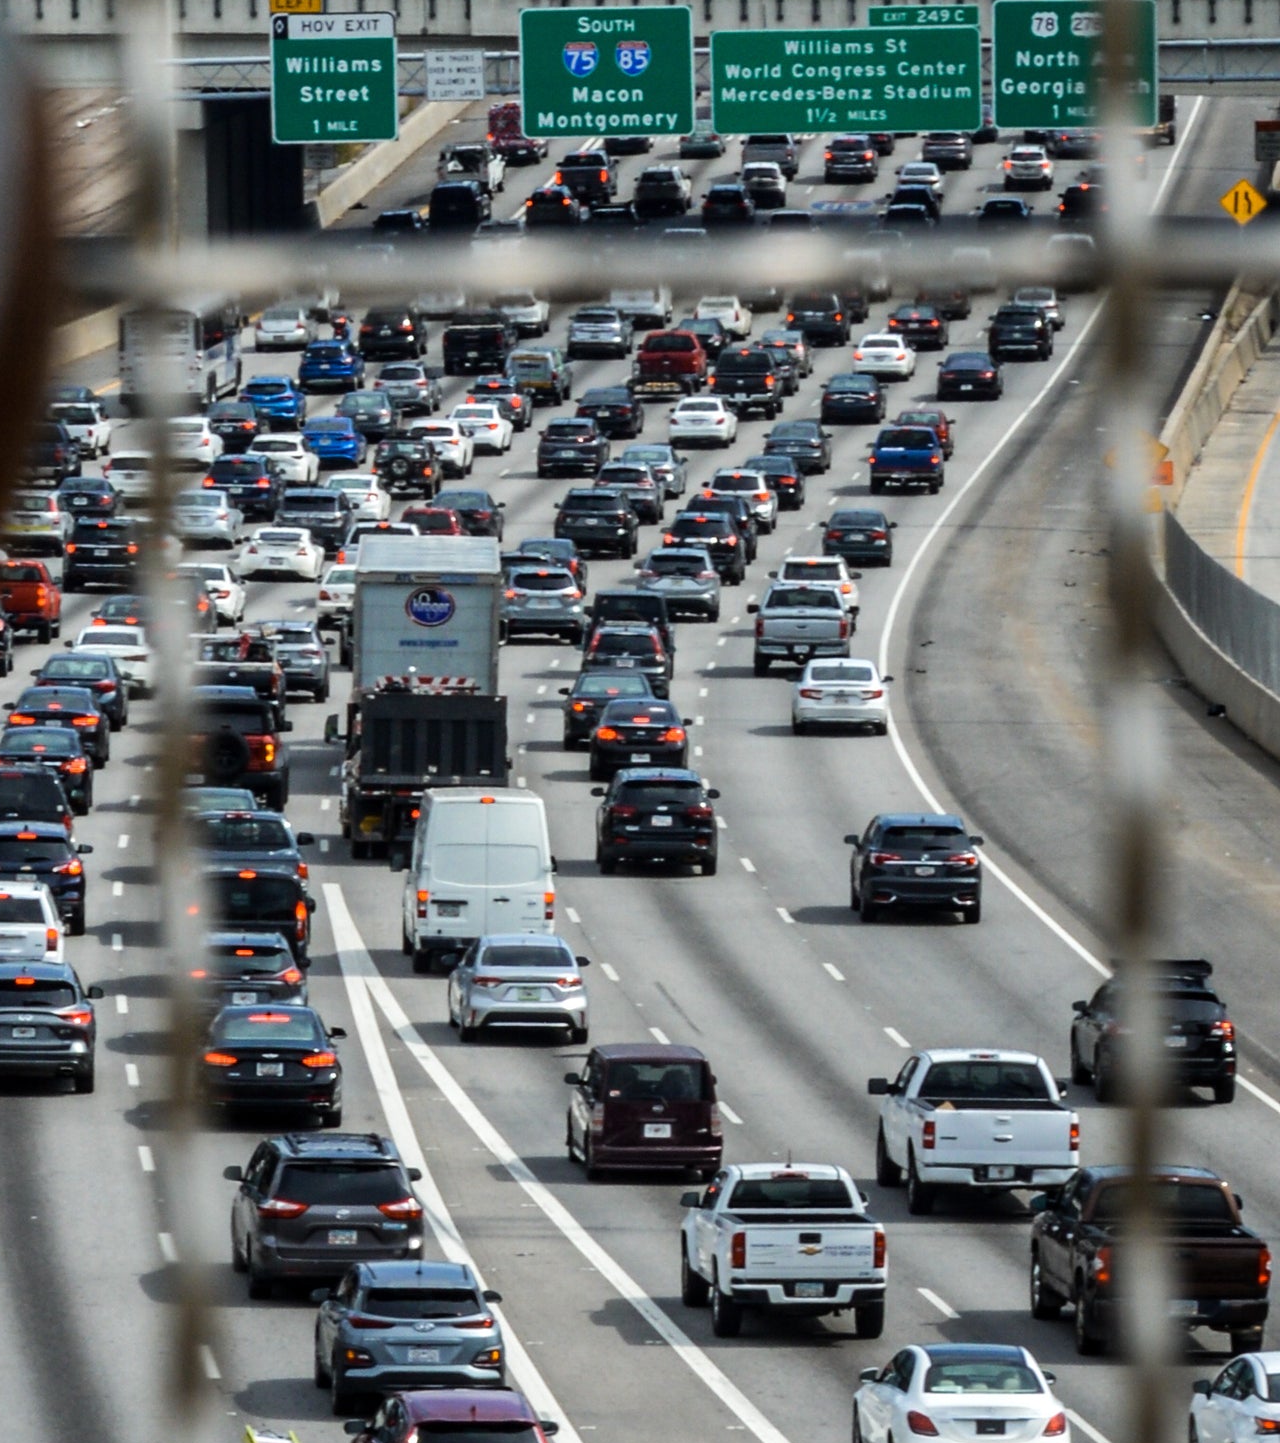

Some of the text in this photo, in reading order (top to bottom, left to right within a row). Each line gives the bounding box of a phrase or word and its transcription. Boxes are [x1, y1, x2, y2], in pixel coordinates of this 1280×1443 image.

[578, 16, 636, 33] SOUTH
[883, 10, 965, 23] EXIT 249 C
[1034, 17, 1054, 32] 78
[301, 19, 381, 33] HOV EXIT
[784, 38, 907, 56] Williams St
[286, 56, 382, 73] Williams
[567, 49, 648, 70] 75 85
[1016, 50, 1081, 68] North
[725, 61, 967, 81] World Congress Center
[300, 85, 370, 103] Street
[572, 86, 644, 103] Macon
[721, 83, 972, 102] Mercedes-Benz Stadium
[1001, 77, 1087, 99] Georgia
[847, 109, 888, 122] MILES
[1052, 105, 1060, 120] 1
[313, 119, 359, 134] 1 MILE
[538, 112, 679, 132] Montgomery
